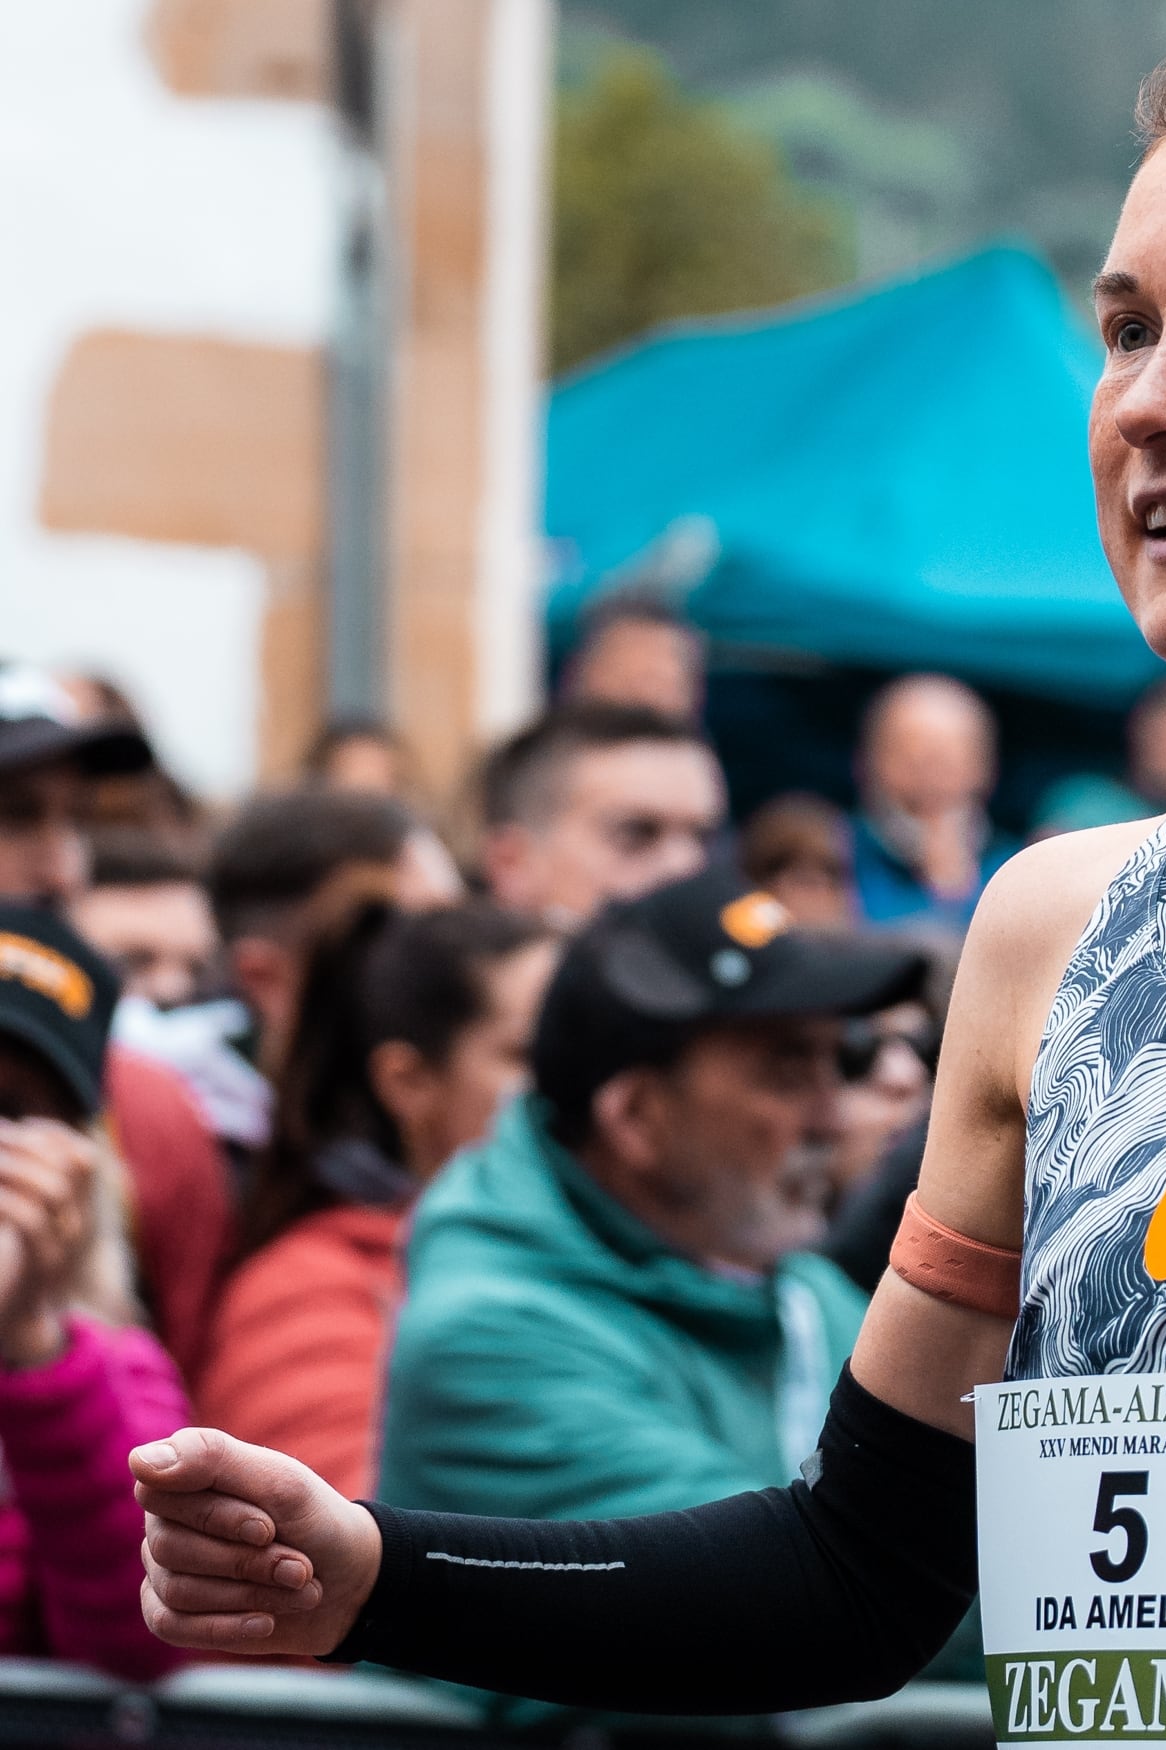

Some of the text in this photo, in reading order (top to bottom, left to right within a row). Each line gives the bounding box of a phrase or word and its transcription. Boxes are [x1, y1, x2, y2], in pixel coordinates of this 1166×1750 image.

[1039, 1438, 1067, 1458] XXV
[1069, 1437, 1118, 1456] MENDI
[1089, 1470, 1149, 1583] 5
[1036, 1596, 1077, 1630] IDA
